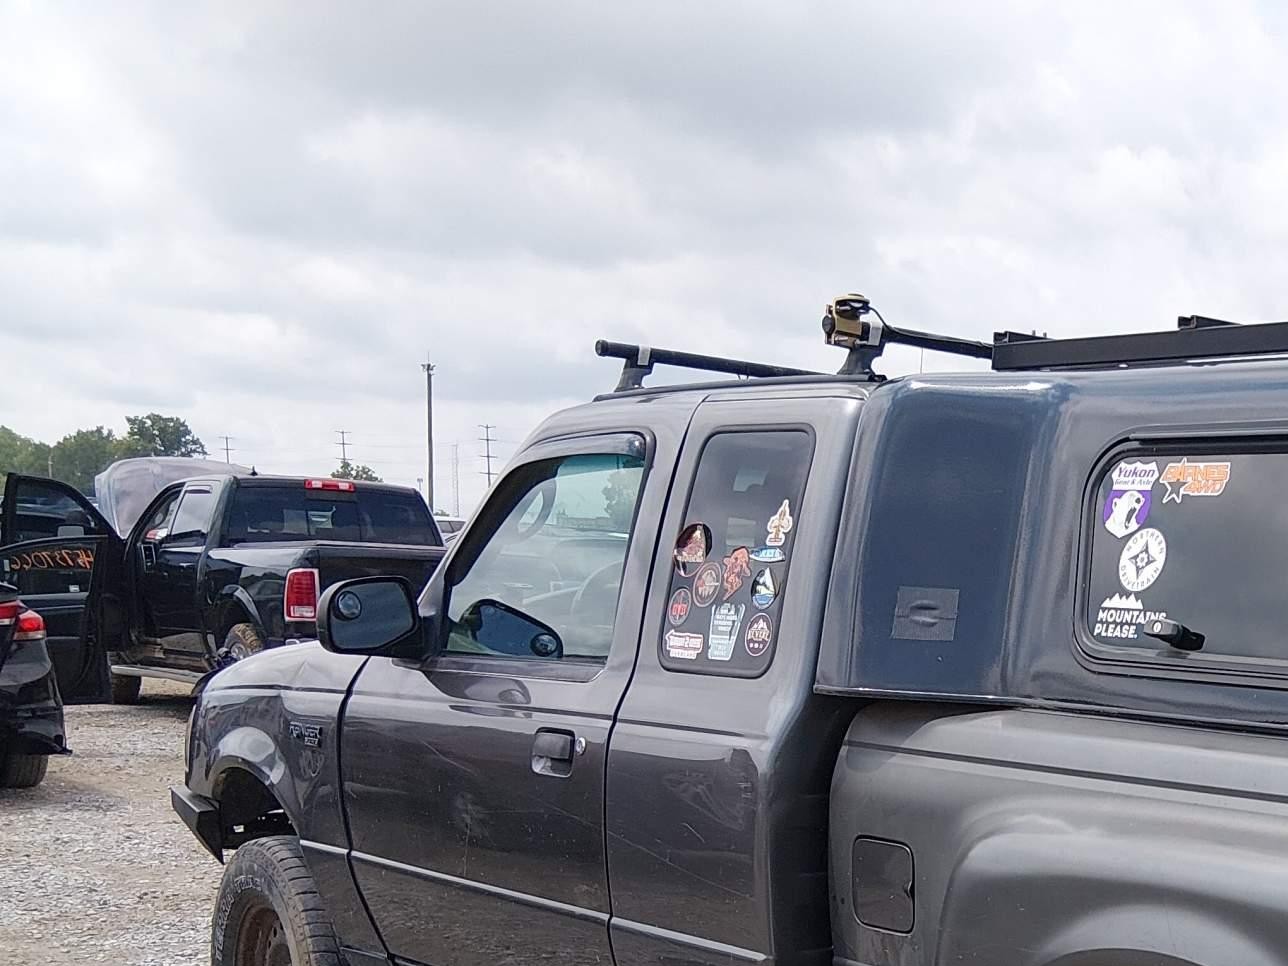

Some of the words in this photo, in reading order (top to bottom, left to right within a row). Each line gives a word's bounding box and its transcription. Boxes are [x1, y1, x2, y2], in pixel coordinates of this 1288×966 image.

[1117, 467, 1155, 478] Yukon
[1126, 530, 1165, 555] NORTHERN
[1094, 623, 1138, 639] PLEASE.
